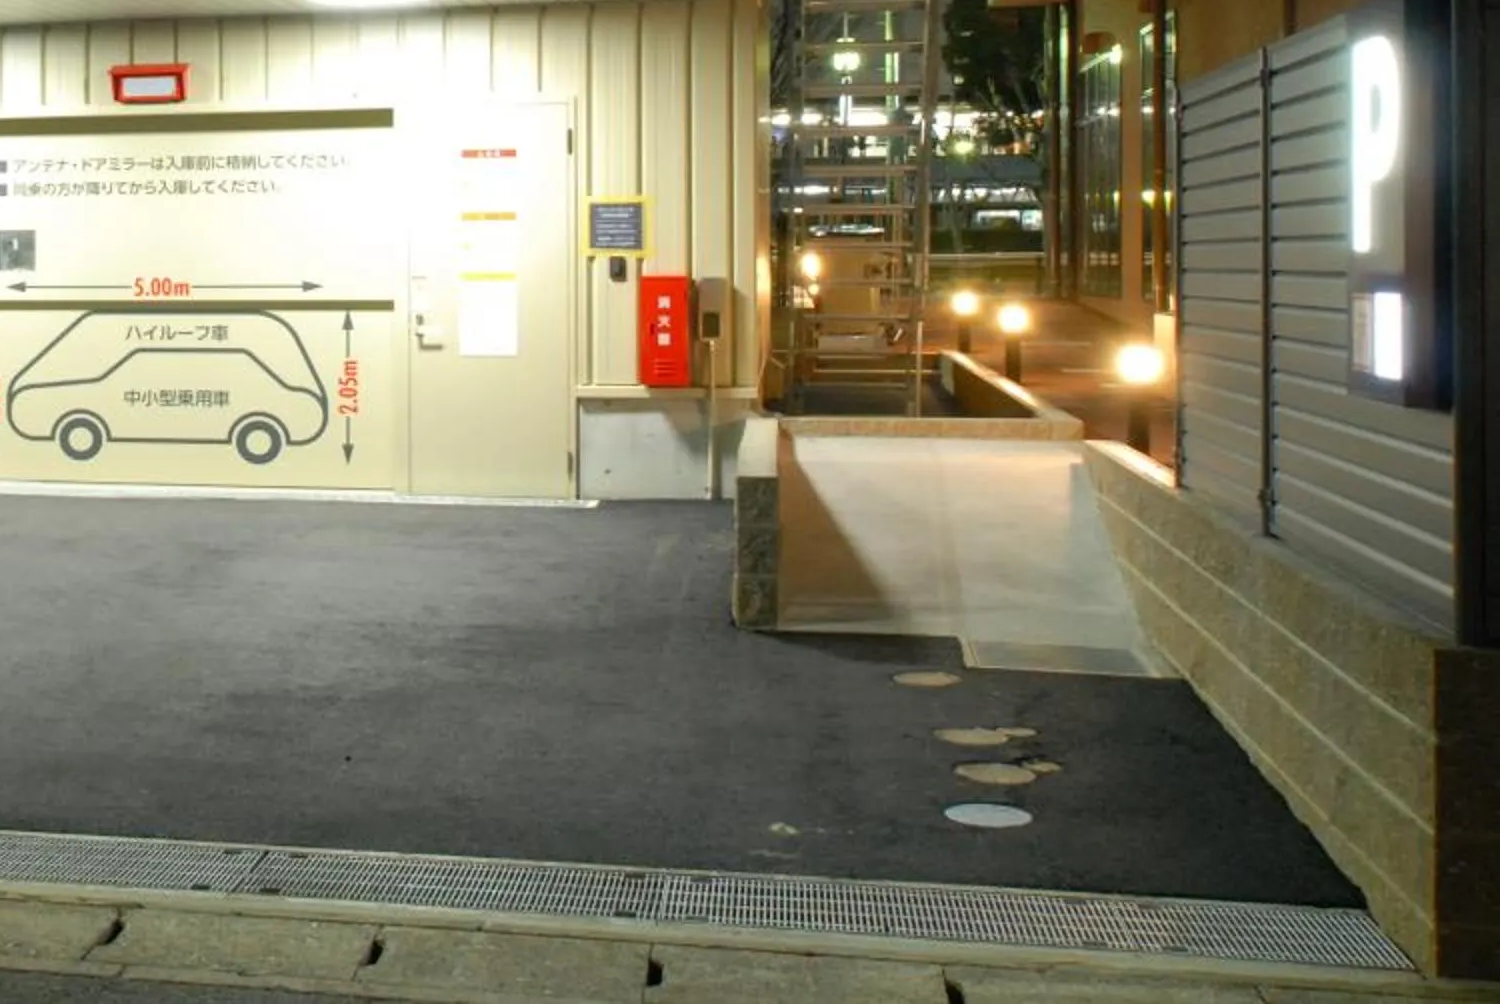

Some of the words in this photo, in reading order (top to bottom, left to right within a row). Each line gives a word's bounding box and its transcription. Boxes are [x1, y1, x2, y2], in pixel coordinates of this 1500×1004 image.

[1351, 36, 1399, 253] P
[133, 277, 191, 297] 5.00m
[124, 324, 229, 342] ハイルーフ車
[338, 359, 358, 415] 2.05m
[123, 389, 231, 408] 中小型乗用車
